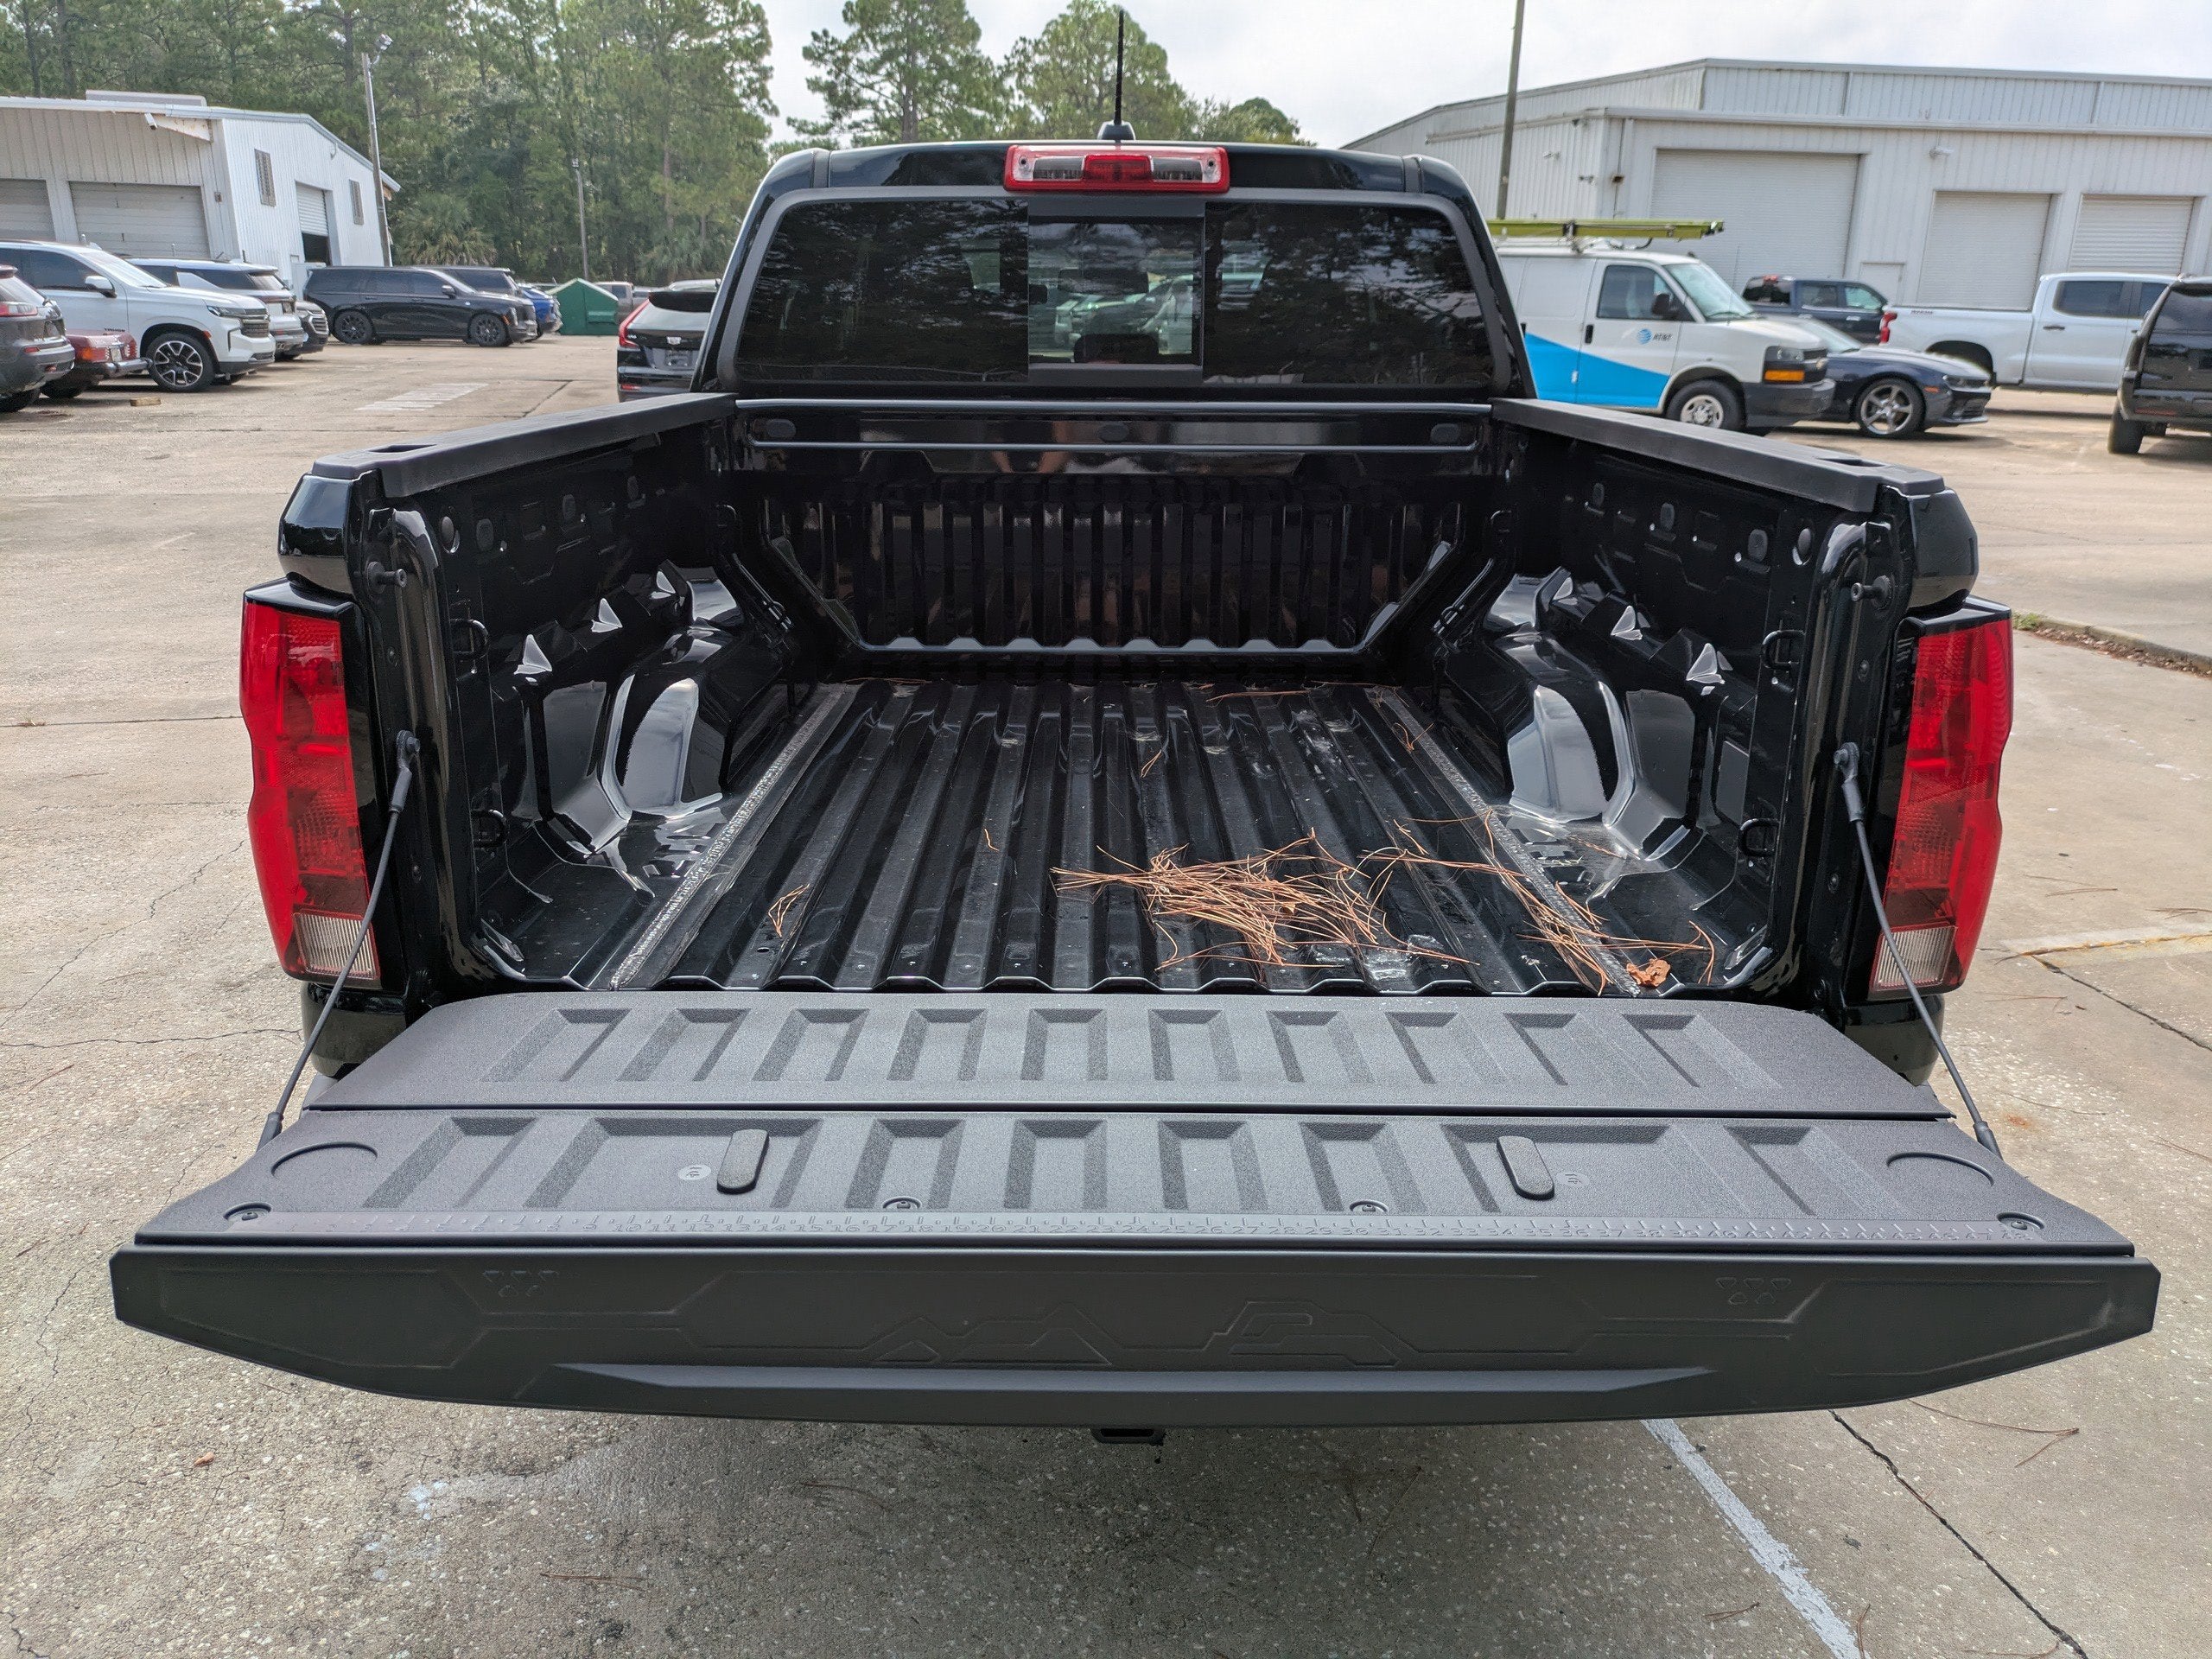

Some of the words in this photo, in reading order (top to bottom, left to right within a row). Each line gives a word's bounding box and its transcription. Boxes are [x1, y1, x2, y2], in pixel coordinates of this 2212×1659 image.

[612, 1224, 641, 1232] 10
[648, 1224, 676, 1232] 11
[685, 1224, 714, 1232] 12
[721, 1224, 751, 1232] 13
[755, 1224, 787, 1232] 14
[794, 1224, 823, 1232] 15
[830, 1224, 860, 1233] 16
[863, 1224, 898, 1233] 17
[904, 1224, 933, 1233] 18
[940, 1224, 969, 1233] 19
[976, 1224, 1007, 1233] 20
[1013, 1224, 1040, 1233] 21
[1050, 1224, 1078, 1234] 22
[1086, 1225, 1116, 1234] 23
[1122, 1225, 1150, 1234] 24
[1160, 1225, 1186, 1234] 25
[1195, 1225, 1225, 1235] 26
[1232, 1226, 1260, 1235] 27
[1268, 1226, 1298, 1235] 28
[1305, 1226, 1333, 1235] 29
[1341, 1226, 1370, 1235] 30
[1377, 1226, 1407, 1236] 31
[1414, 1227, 1444, 1236] 32
[1451, 1227, 1479, 1236] 33
[1486, 1227, 1516, 1236] 34
[1523, 1228, 1553, 1236] 35
[1560, 1228, 1590, 1236] 36
[1596, 1229, 1626, 1237] 37
